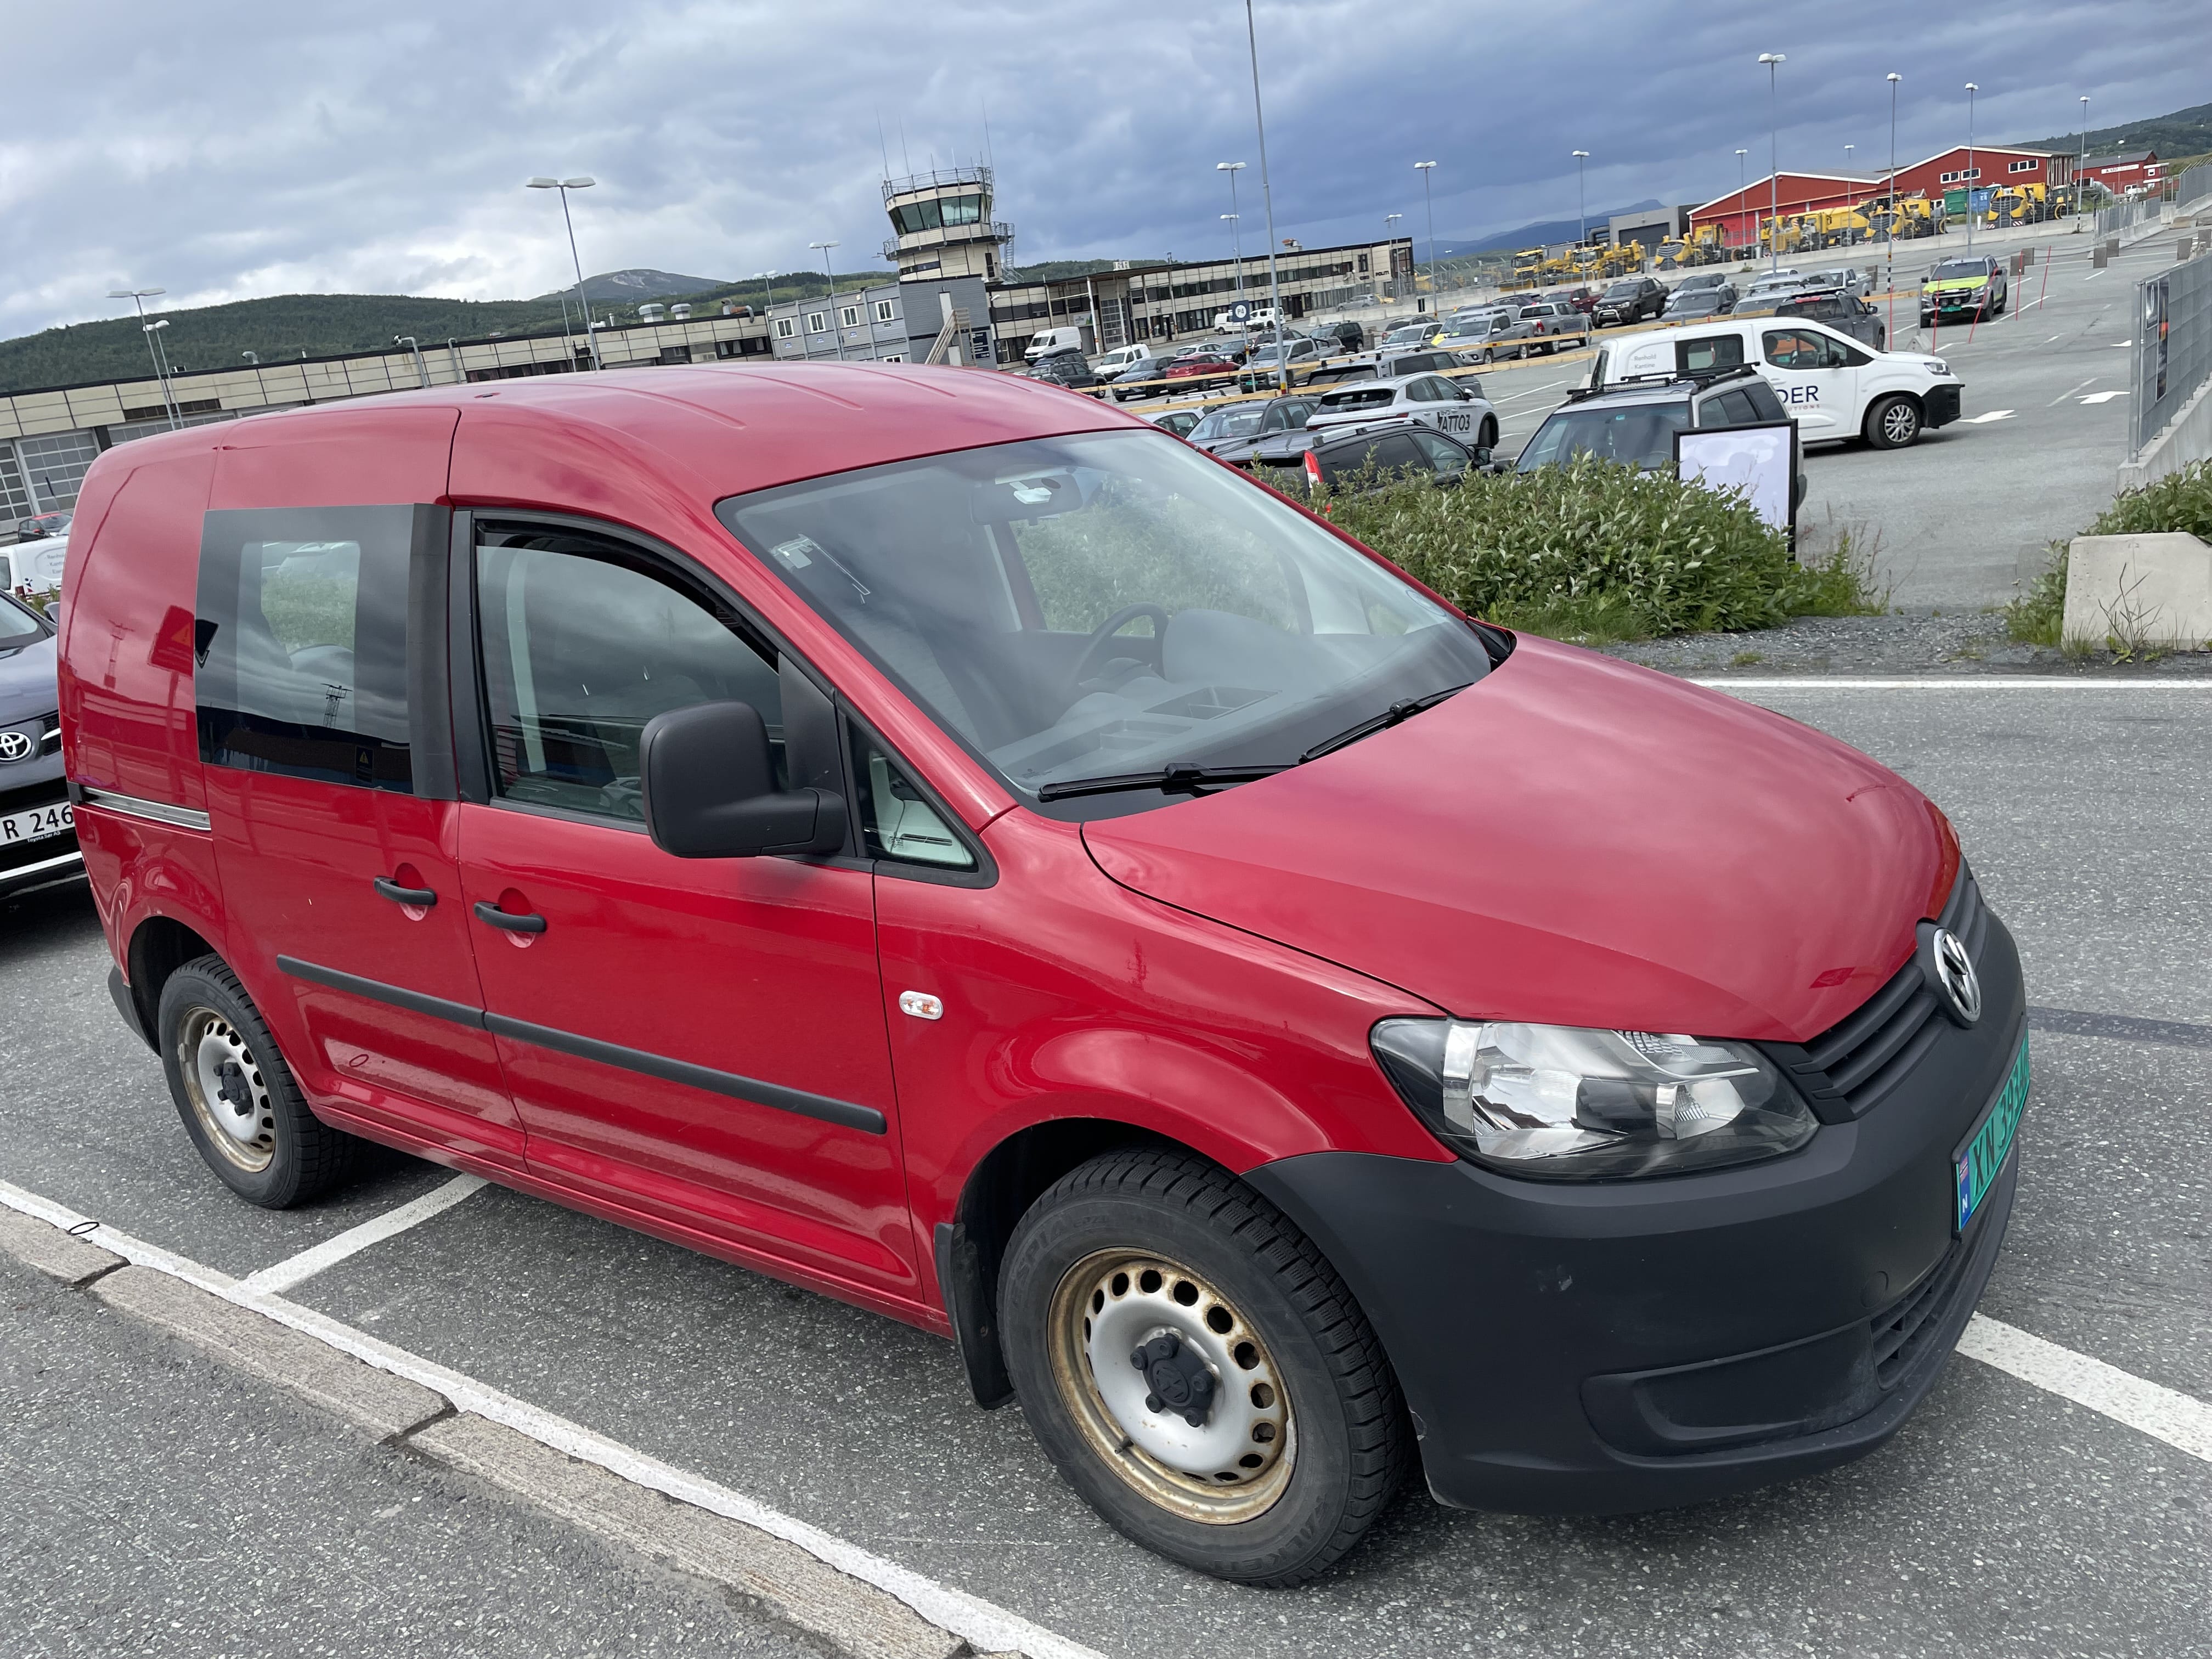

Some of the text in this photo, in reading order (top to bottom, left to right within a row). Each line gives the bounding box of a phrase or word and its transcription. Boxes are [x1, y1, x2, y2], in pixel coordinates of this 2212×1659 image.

[2, 804, 74, 839] R 246
[27, 835, 44, 843] Toyota
[1973, 1116, 1995, 1197] XN
[1962, 1194, 1968, 1213] N
